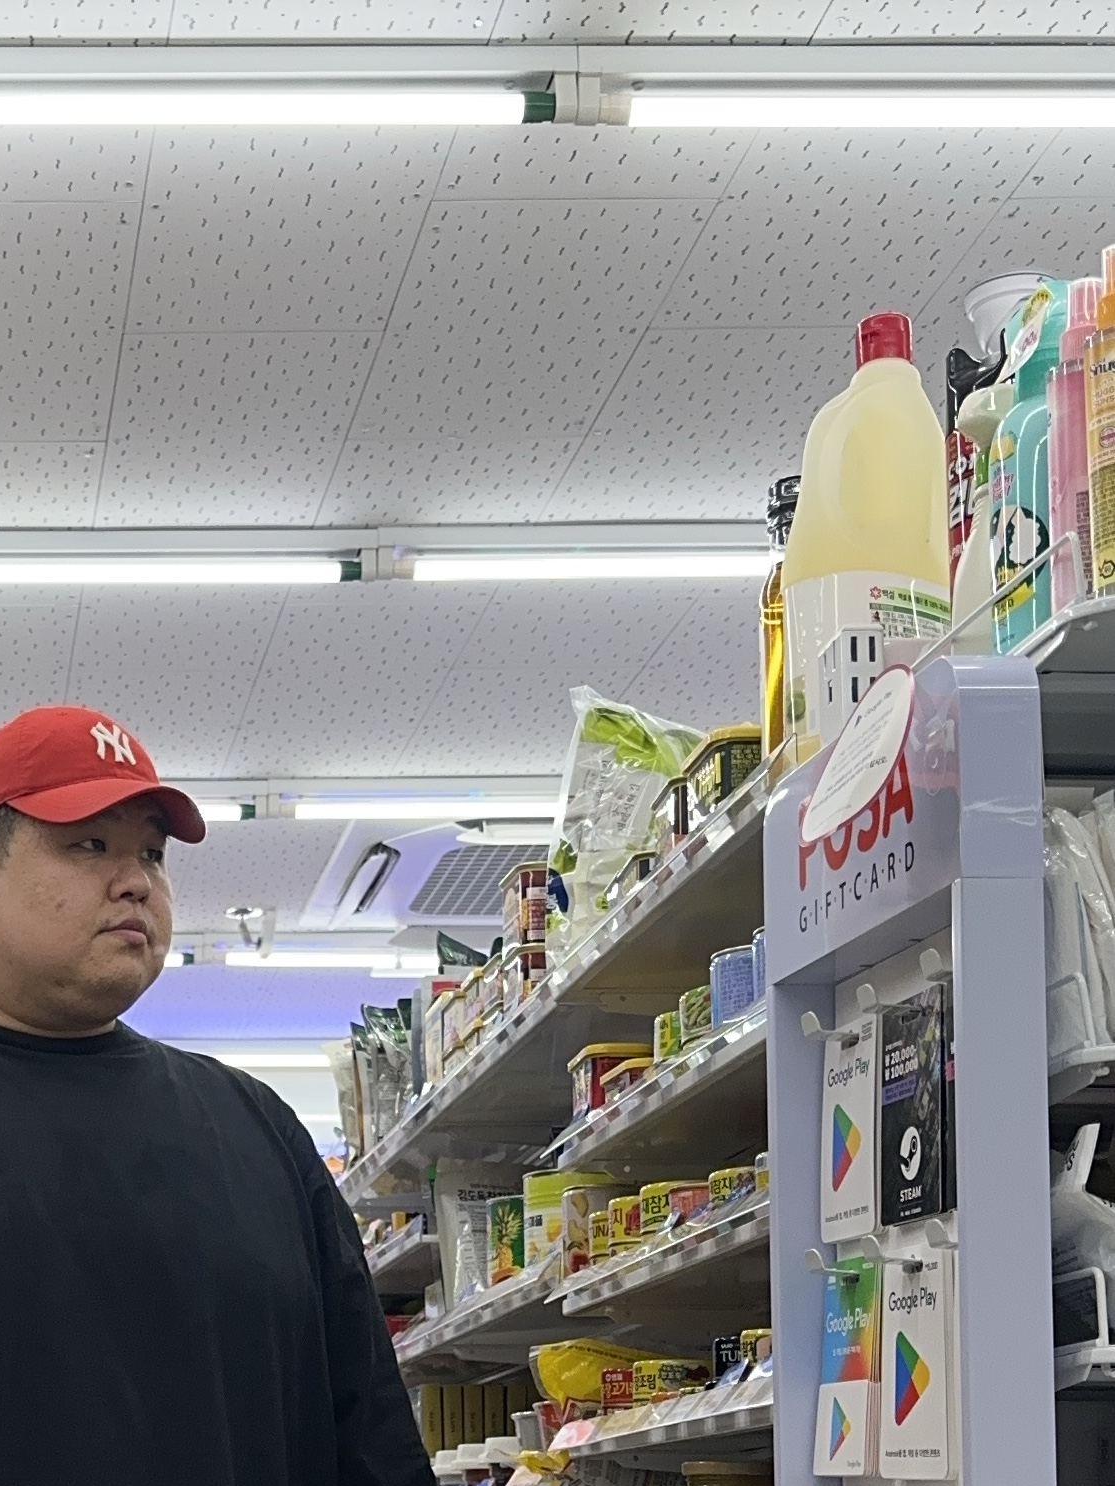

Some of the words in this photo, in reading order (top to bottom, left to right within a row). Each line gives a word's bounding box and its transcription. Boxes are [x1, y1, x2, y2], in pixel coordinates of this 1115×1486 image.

[827, 1062, 853, 1087] Google
[855, 1057, 871, 1078] Play
[900, 1185, 922, 1203] STEAM
[889, 1289, 919, 1314] Google
[920, 1286, 938, 1311] Play
[827, 1310, 853, 1336] Google
[854, 1308, 873, 1330] Play
